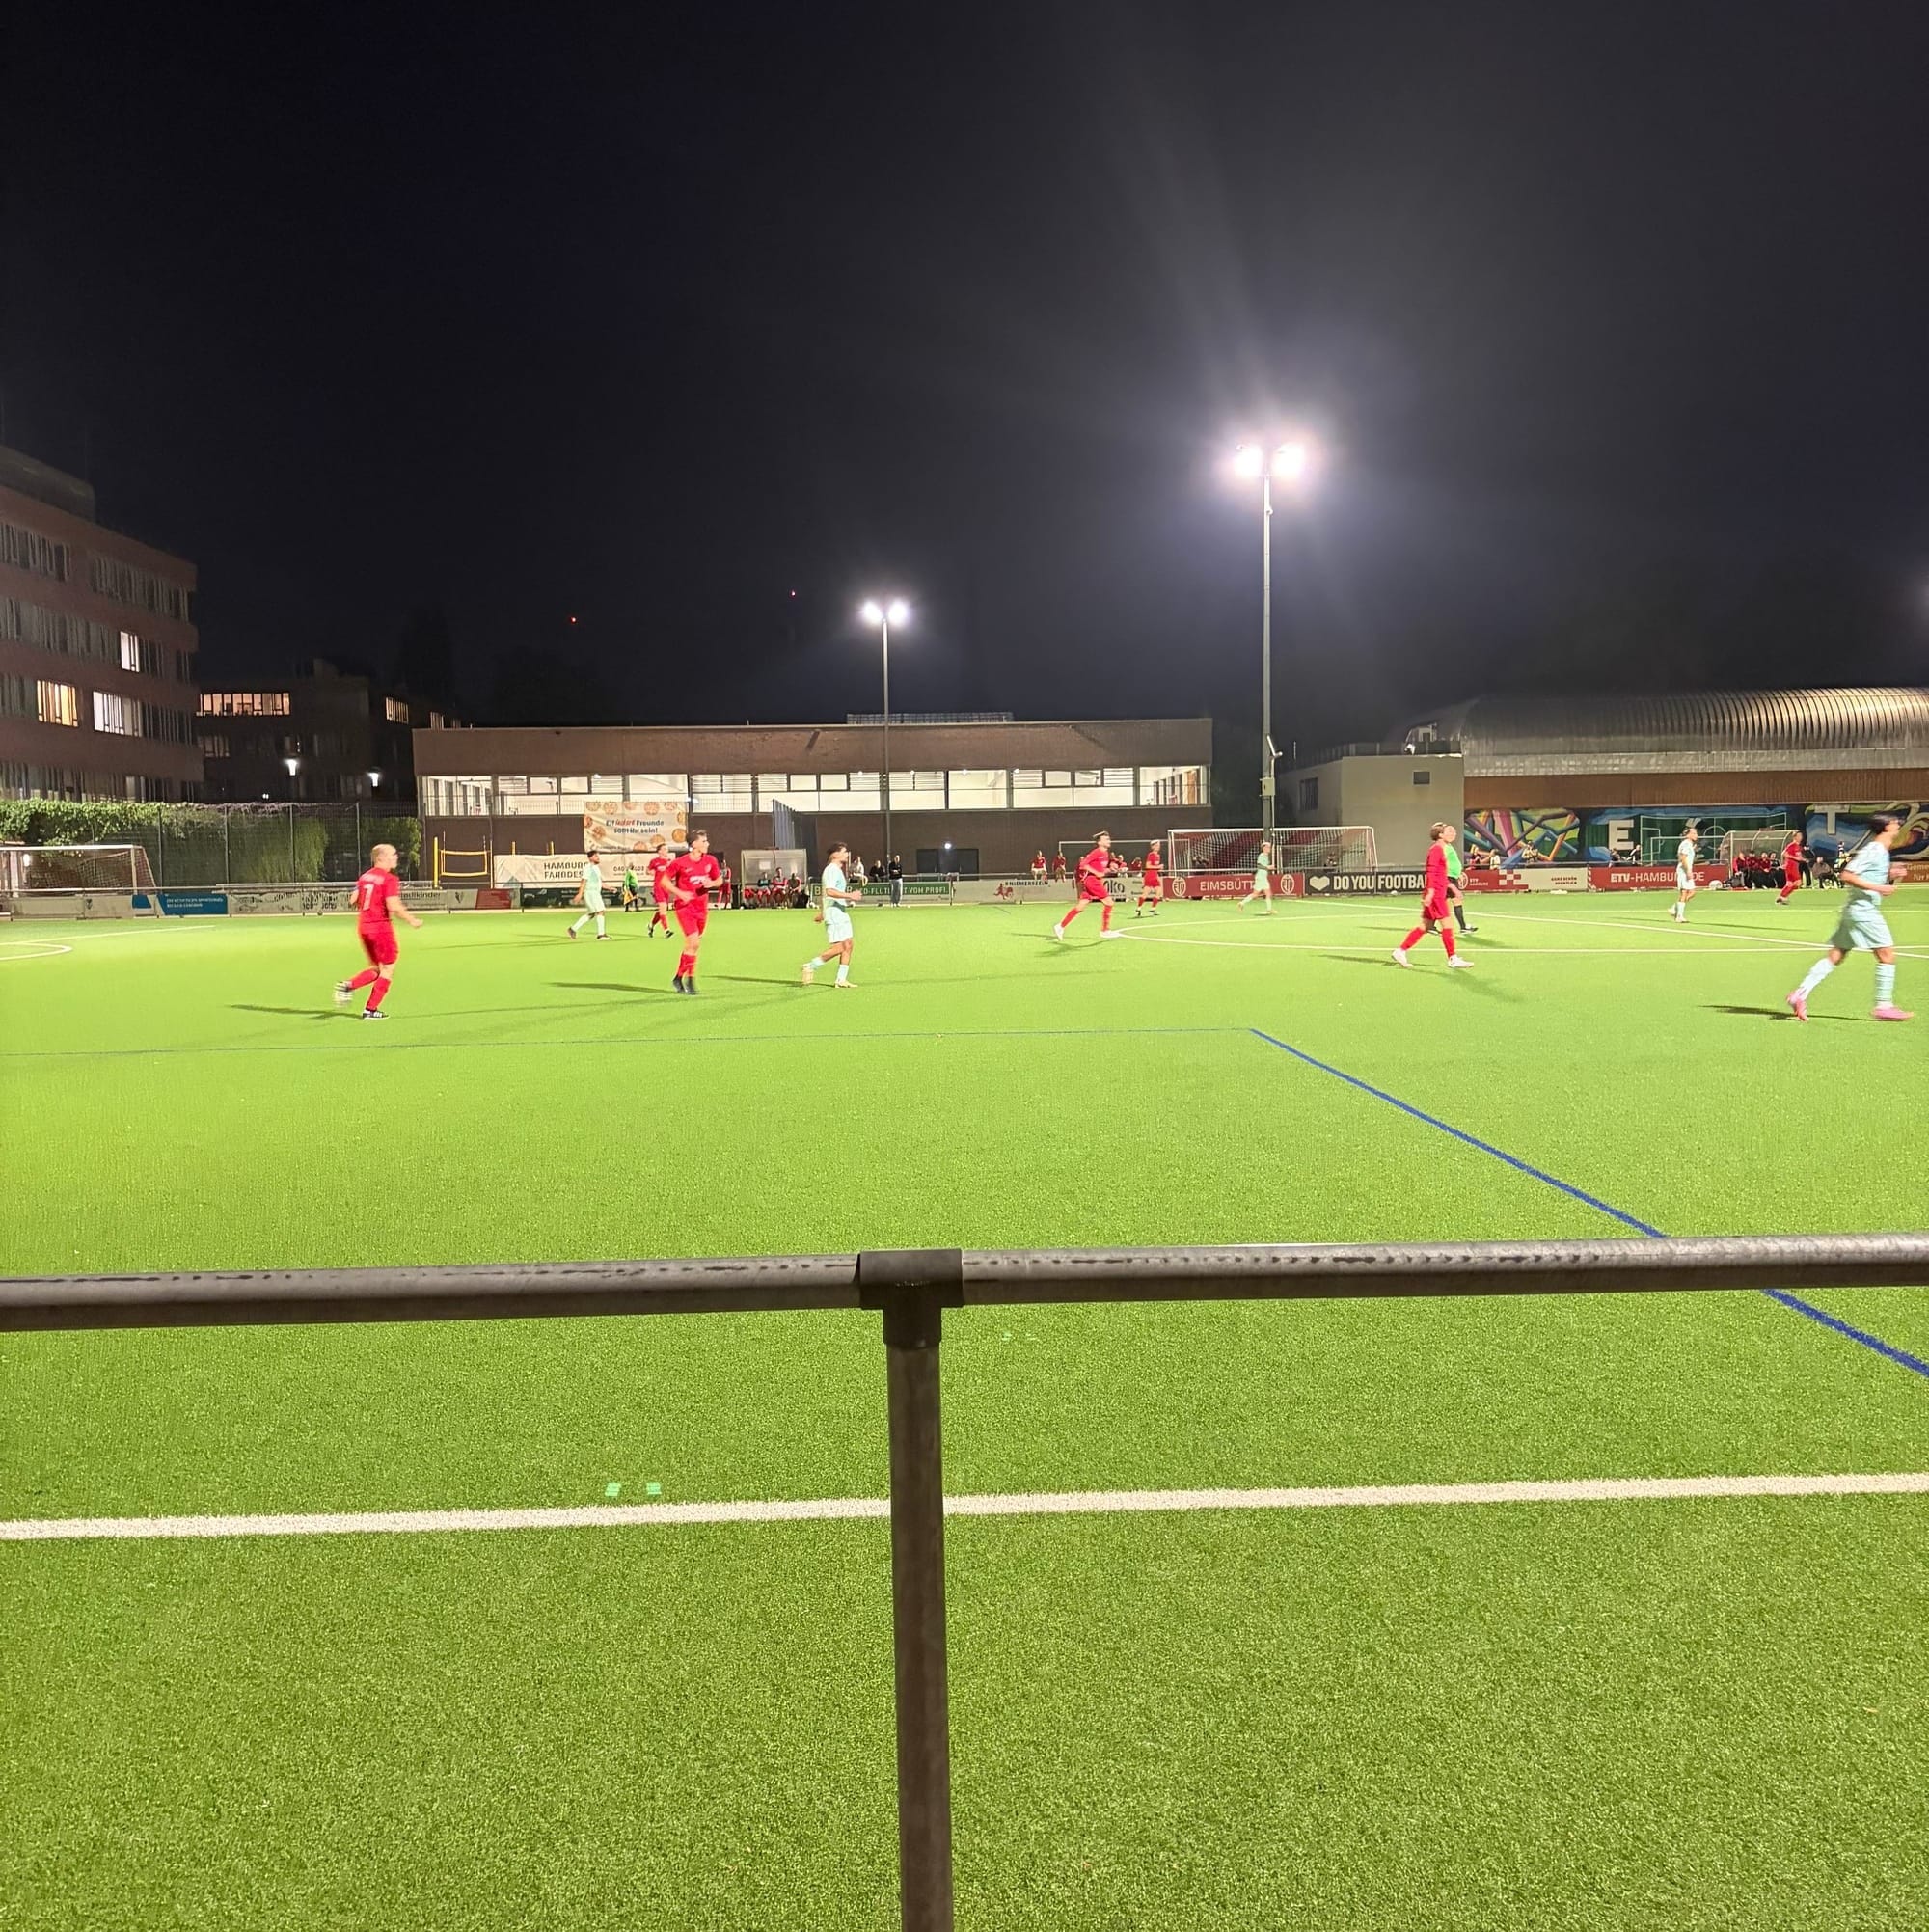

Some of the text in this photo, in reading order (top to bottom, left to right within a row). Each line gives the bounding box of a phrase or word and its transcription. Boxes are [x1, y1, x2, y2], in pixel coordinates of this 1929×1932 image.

[1813, 803, 1851, 835] T
[1608, 818, 1634, 850] E
[1199, 878, 1255, 891] EIMSBÜTT
[1333, 874, 1427, 890] DO YOU FOOTBA
[1610, 871, 1705, 883] ETV-HAMBUDE
